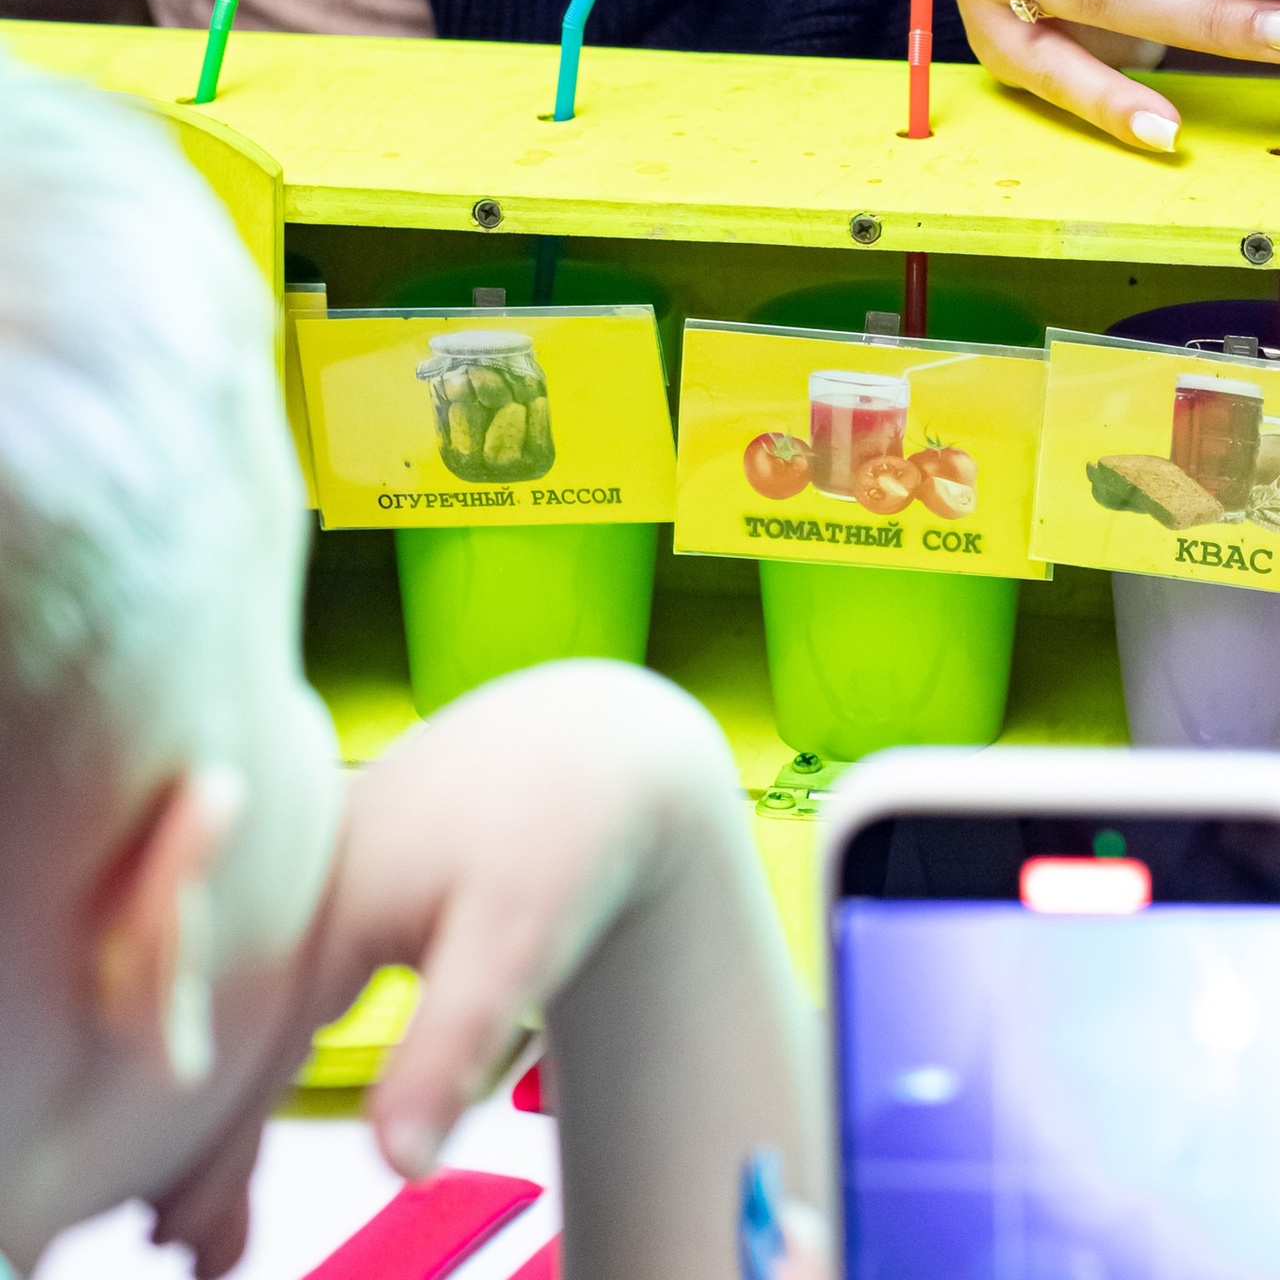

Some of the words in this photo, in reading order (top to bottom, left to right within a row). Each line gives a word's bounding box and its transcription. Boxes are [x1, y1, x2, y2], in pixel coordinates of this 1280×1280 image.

[377, 486, 516, 509] ОГУРЕЧНЫЙ
[531, 487, 622, 506] РАССОЛ
[744, 516, 904, 549] ТОМАТНЫЙ
[921, 529, 983, 554] СОК
[1174, 537, 1274, 575] КВАС
